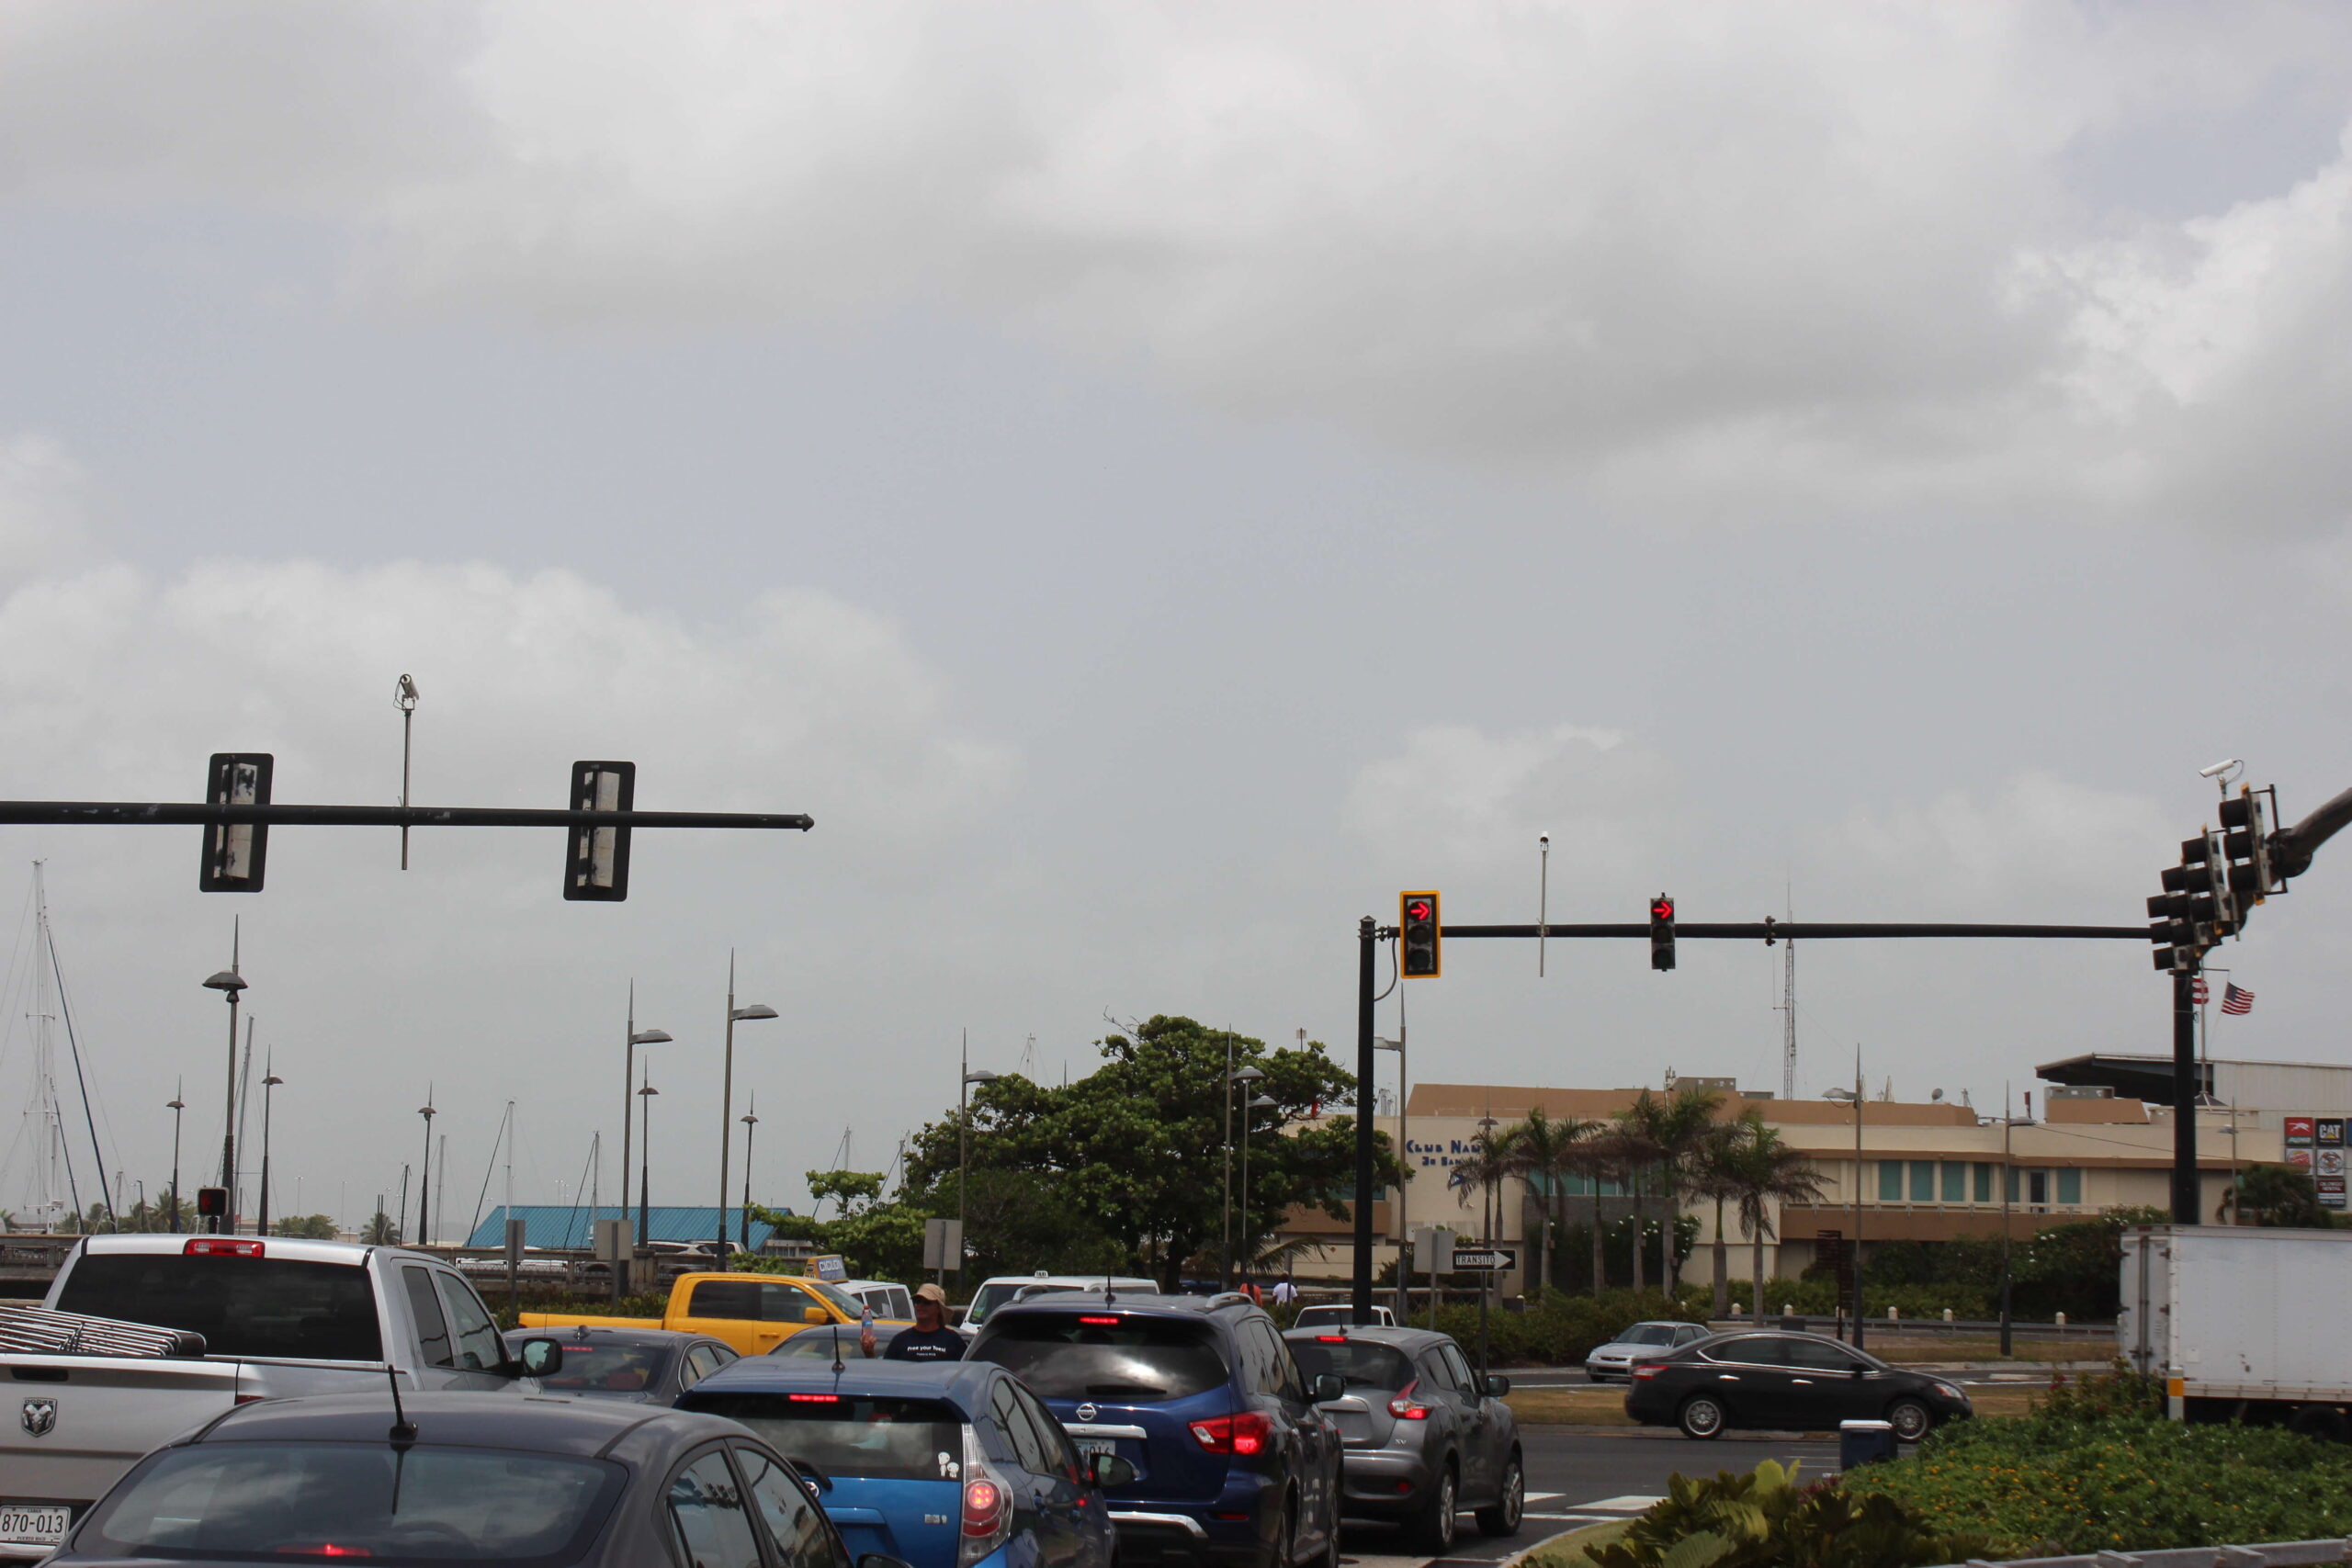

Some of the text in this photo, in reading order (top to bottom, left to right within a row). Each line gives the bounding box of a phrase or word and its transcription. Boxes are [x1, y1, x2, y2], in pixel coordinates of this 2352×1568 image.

[2319, 1124, 2341, 1139] CAT
[1456, 1256, 1496, 1265] TRANSITO
[2, 1514, 63, 1533] 870-013
